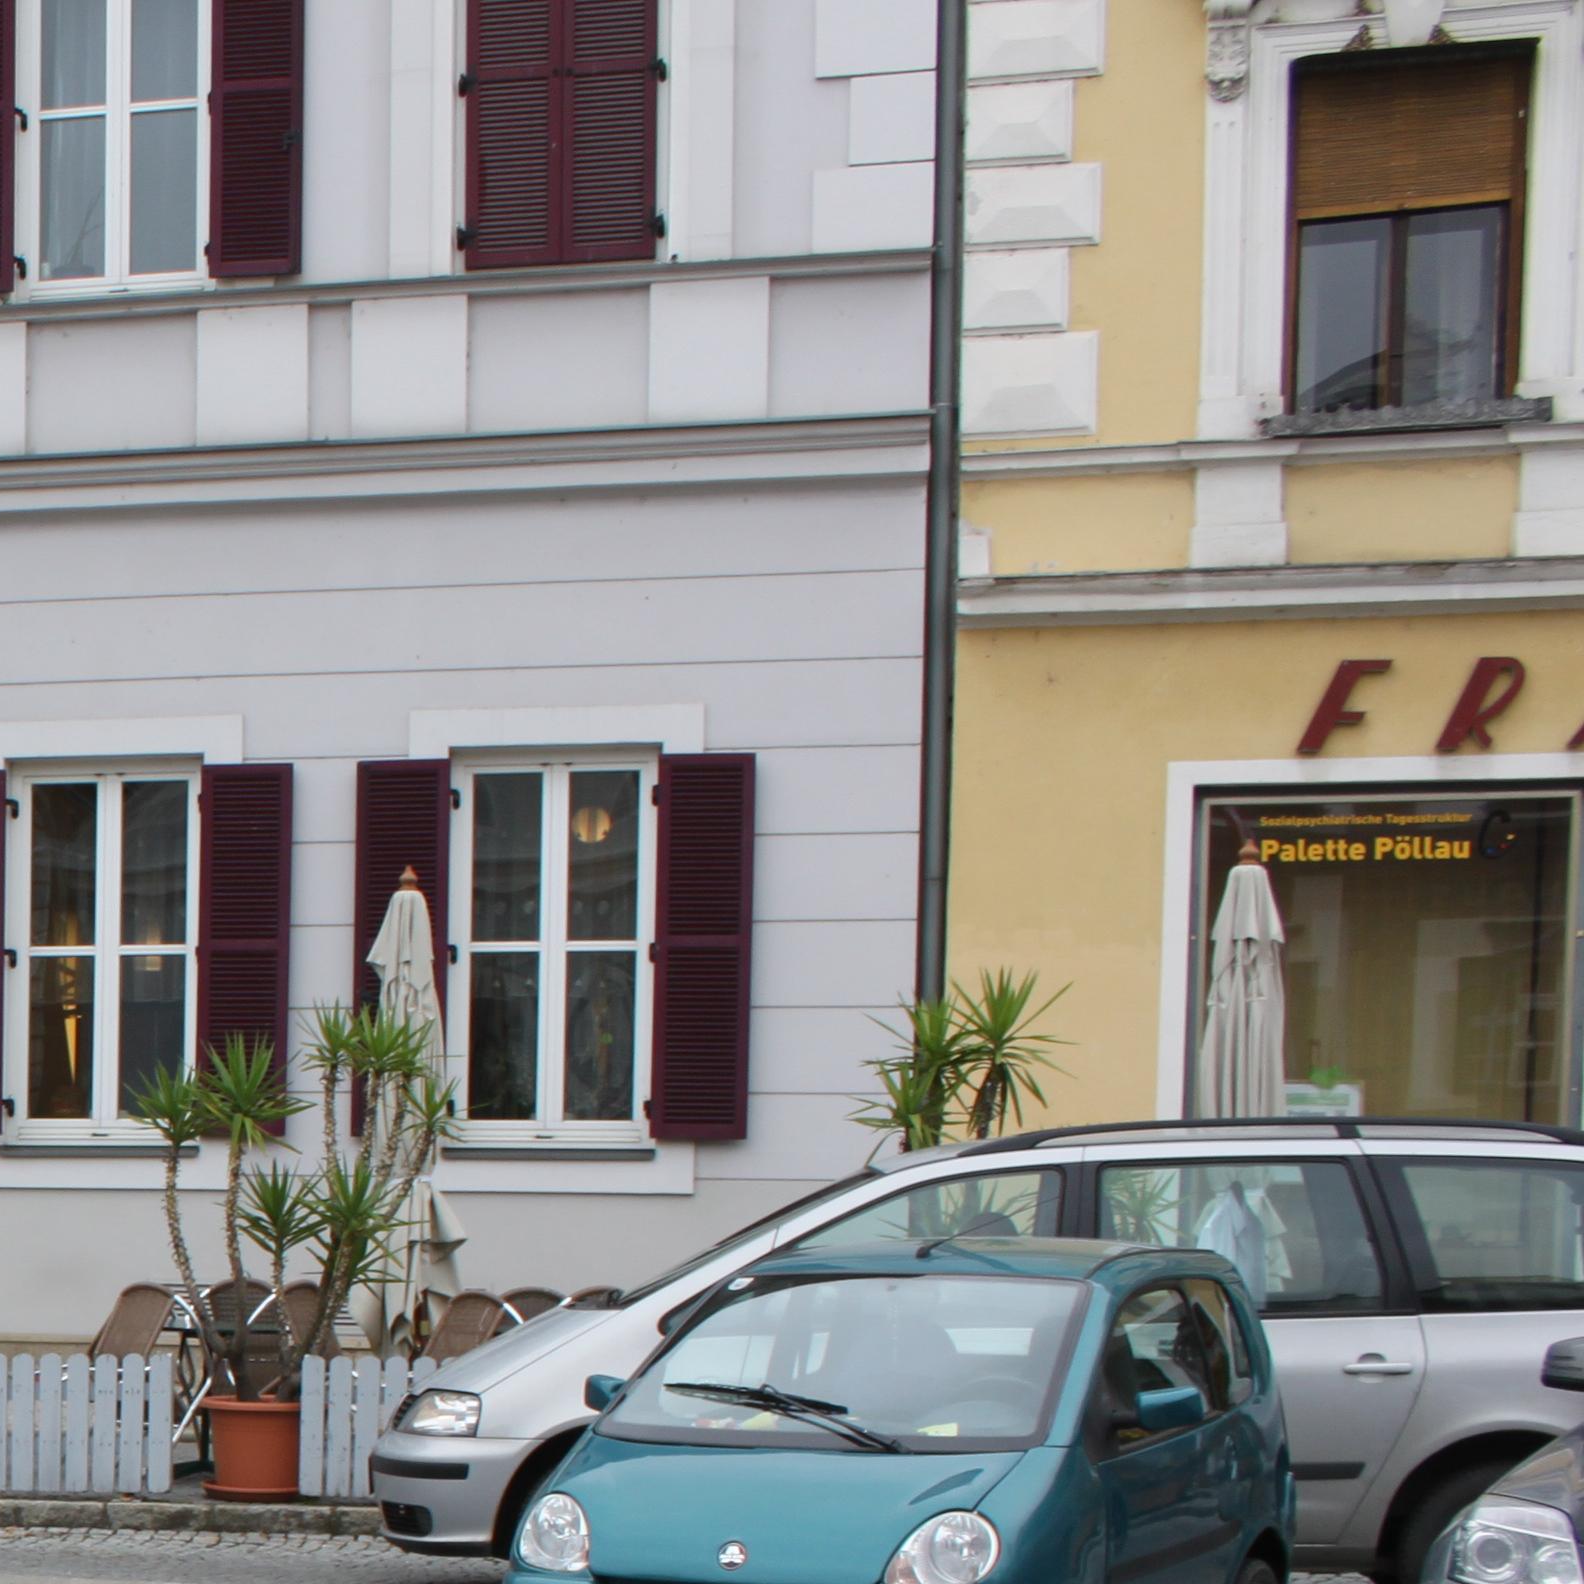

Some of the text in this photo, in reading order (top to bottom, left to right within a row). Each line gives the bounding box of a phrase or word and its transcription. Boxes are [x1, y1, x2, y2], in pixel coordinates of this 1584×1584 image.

[1296, 656, 1584, 755] FR
[1259, 812, 1473, 828] Sozialpsychiatrische Tagesstruktur
[1260, 835, 1471, 863] Palette Pöllau
